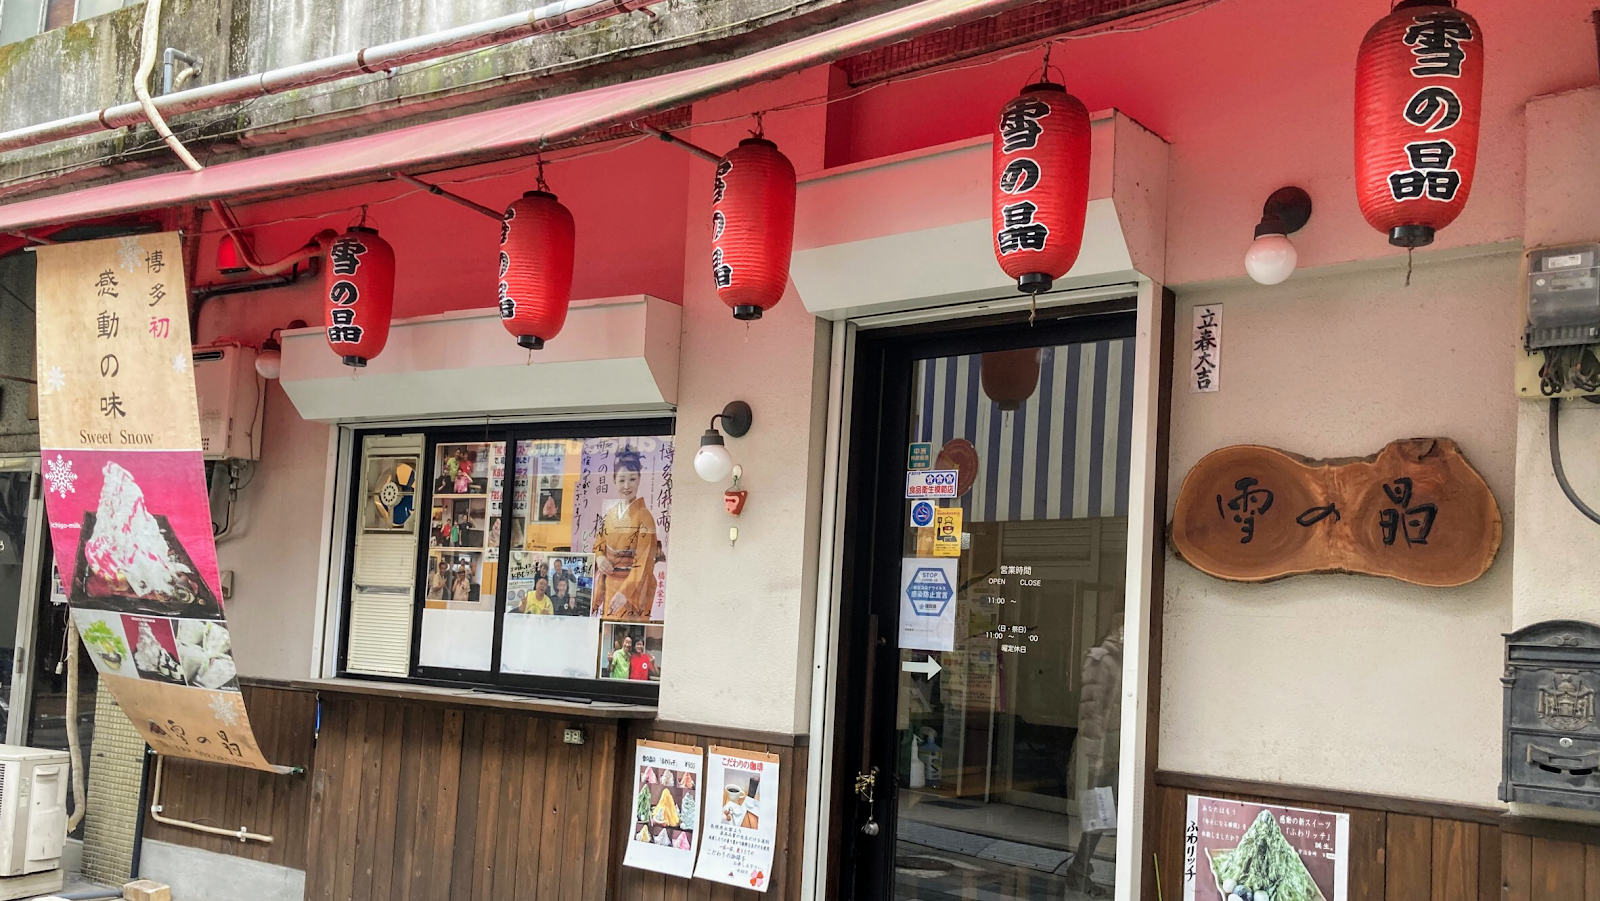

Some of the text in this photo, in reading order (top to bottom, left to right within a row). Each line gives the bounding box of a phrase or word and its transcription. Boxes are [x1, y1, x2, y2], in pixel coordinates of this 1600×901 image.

[1389, 9, 1474, 202] 雪の晶
[996, 98, 1051, 256] 雪の晶
[145, 249, 170, 339] 博多初
[327, 237, 366, 344] 雪の晶
[95, 268, 126, 420] 感動の味
[1194, 308, 1218, 391] 立春大吉
[80, 429, 154, 445] Sweet Snow
[909, 485, 954, 494] 食品衛生模範店
[1216, 476, 1438, 548] 雪の晶
[1000, 565, 1032, 575] 営業時間
[1020, 579, 1042, 587] CLOSE
[985, 631, 1003, 639] 11:00
[722, 758, 764, 772] こだわりの珈琲
[1202, 804, 1236, 816] あなたはもう
[1279, 814, 1331, 829] 感動の新スイーツ
[1286, 827, 1331, 841] 「ふわリッチ」
[1184, 820, 1199, 882] ふわリッチ
